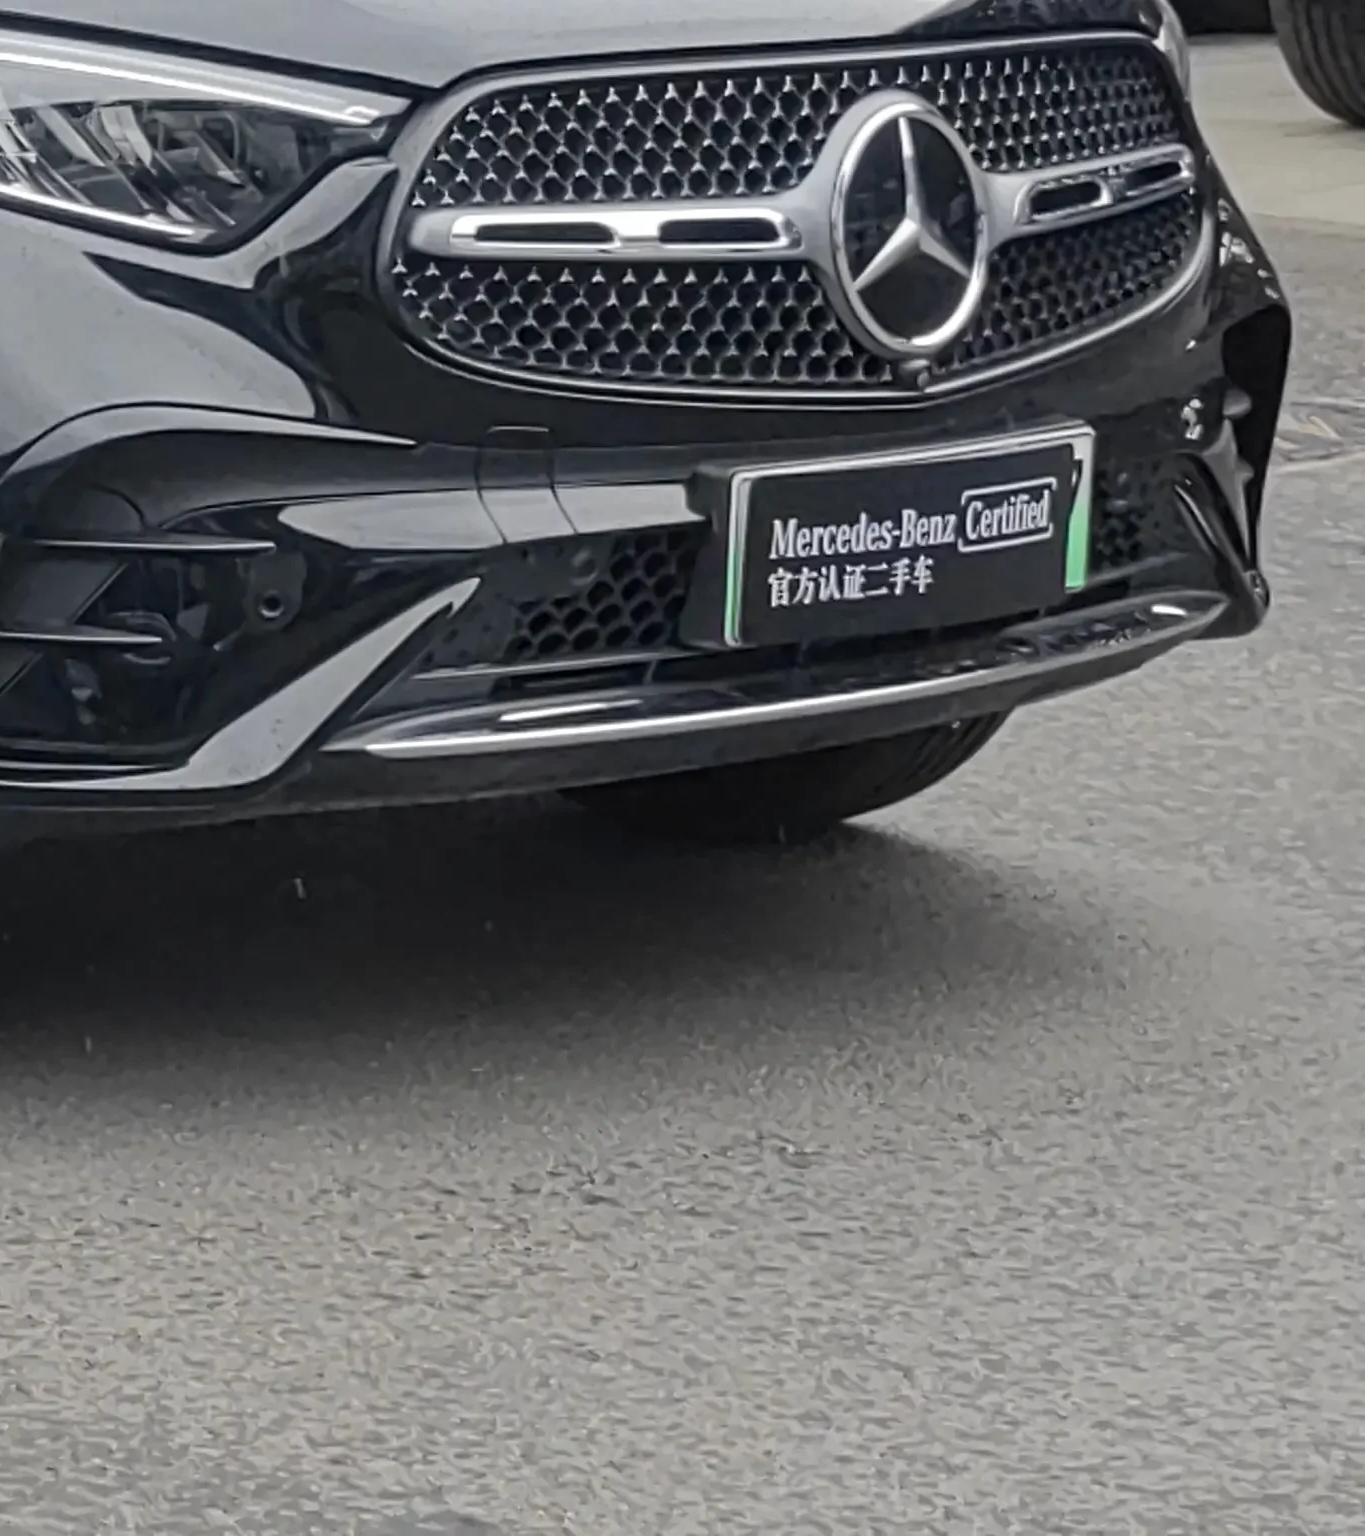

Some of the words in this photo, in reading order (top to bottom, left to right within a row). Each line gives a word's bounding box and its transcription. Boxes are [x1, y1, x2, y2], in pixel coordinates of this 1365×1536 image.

[769, 508, 957, 560] Mercedes-Benz
[964, 488, 1051, 541] Certified
[768, 554, 934, 608] 官方认证二手车
